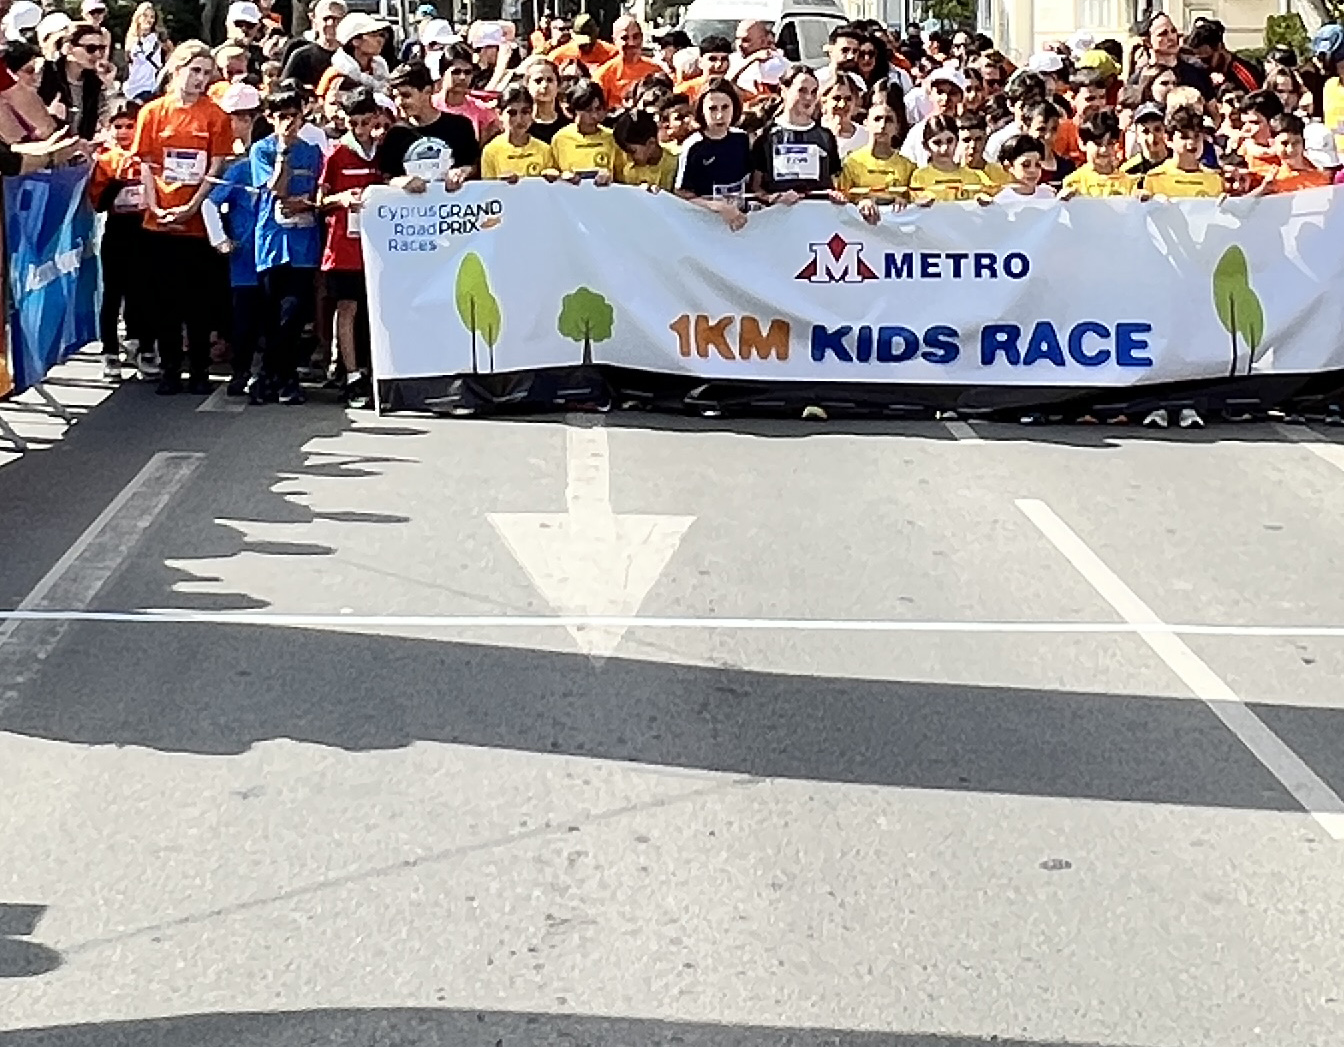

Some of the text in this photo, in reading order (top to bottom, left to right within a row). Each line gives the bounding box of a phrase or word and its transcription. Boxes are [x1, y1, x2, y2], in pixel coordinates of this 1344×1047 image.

[378, 199, 502, 221] Cyprus GRAND
[394, 219, 480, 236] Road PRIX
[388, 238, 437, 252] Races
[884, 252, 1030, 279] METRO
[669, 314, 1154, 367] 1KM KIDS RACE
